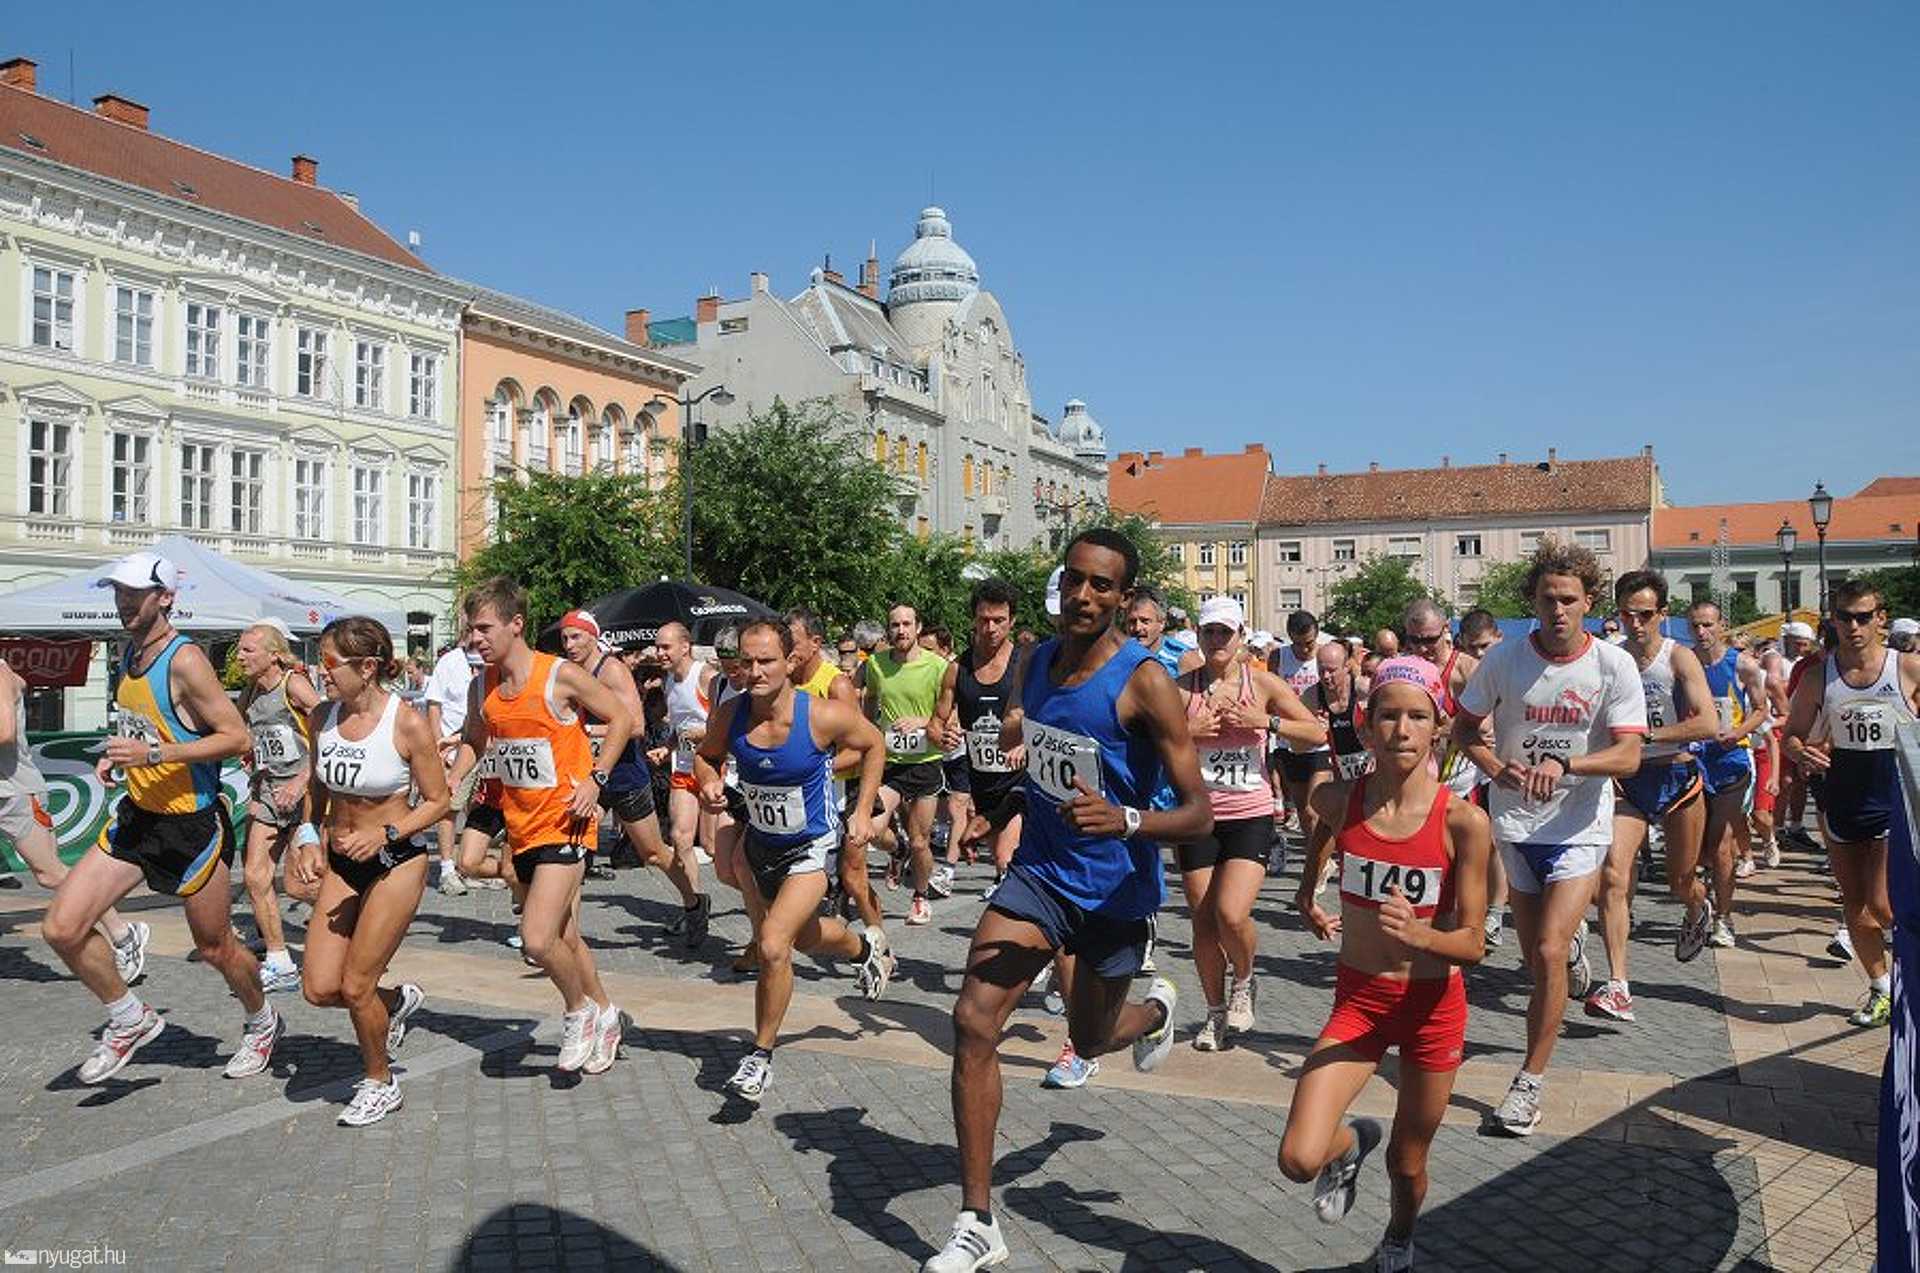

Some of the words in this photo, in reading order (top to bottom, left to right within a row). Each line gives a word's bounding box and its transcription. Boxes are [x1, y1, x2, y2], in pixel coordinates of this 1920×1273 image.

[602, 628, 658, 644] GUINNESS
[1, 645, 77, 671] cony
[893, 735, 919, 750] 210
[1846, 722, 1882, 742] 108
[336, 746, 366, 760] asics
[1538, 739, 1572, 749] asics
[977, 748, 1006, 766] 196
[323, 759, 362, 788] 107
[504, 758, 540, 780] 176
[1038, 750, 1077, 791] 110
[754, 802, 789, 828] 101
[1360, 861, 1426, 905] 149
